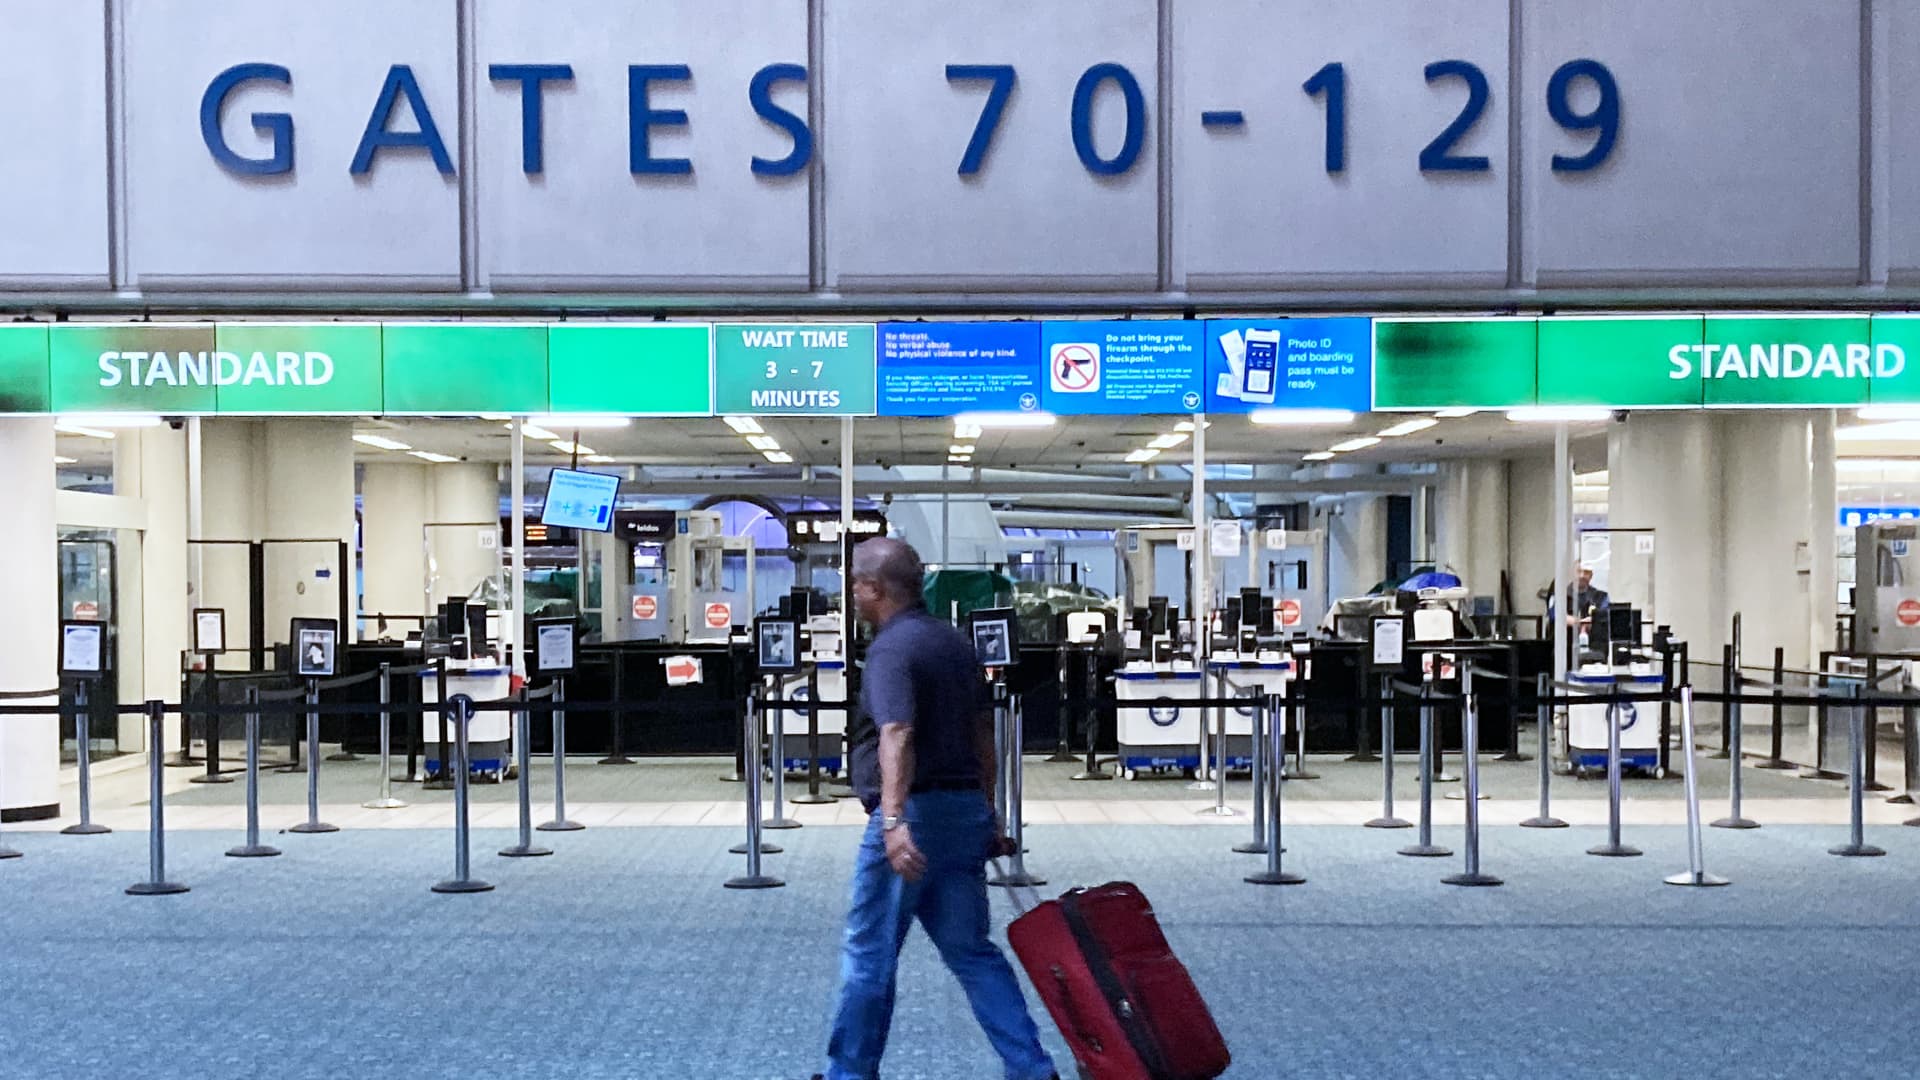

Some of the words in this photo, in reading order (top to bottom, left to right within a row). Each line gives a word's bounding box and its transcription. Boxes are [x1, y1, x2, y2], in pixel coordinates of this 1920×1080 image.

[201, 62, 812, 176] GATES
[742, 331, 795, 348] WAIT
[799, 331, 848, 347] TIME
[1106, 334, 1119, 342] Do
[1121, 334, 1136, 342] not
[1138, 334, 1162, 344] bring
[1164, 335, 1185, 343] your
[1288, 338, 1318, 349] Photo
[1321, 338, 1332, 348] ID
[886, 350, 897, 358] No
[899, 350, 932, 359] physical
[933, 350, 967, 358] violence
[980, 350, 995, 359] any
[997, 348, 1017, 357] kind.
[1106, 344, 1138, 352] firearm
[1140, 344, 1175, 354] through
[1178, 344, 1193, 352] the
[1106, 354, 1156, 364] checkpoint.
[1288, 352, 1307, 363] and
[1309, 351, 1354, 363] boarding
[1668, 343, 1907, 380] STANDARD
[98, 351, 335, 387] STANDARD
[765, 361, 778, 379] 3
[811, 361, 824, 378] 7
[1288, 368, 1312, 377] pass
[1315, 366, 1339, 375] must
[1342, 365, 1355, 375] be
[751, 390, 841, 407] MINUTES
